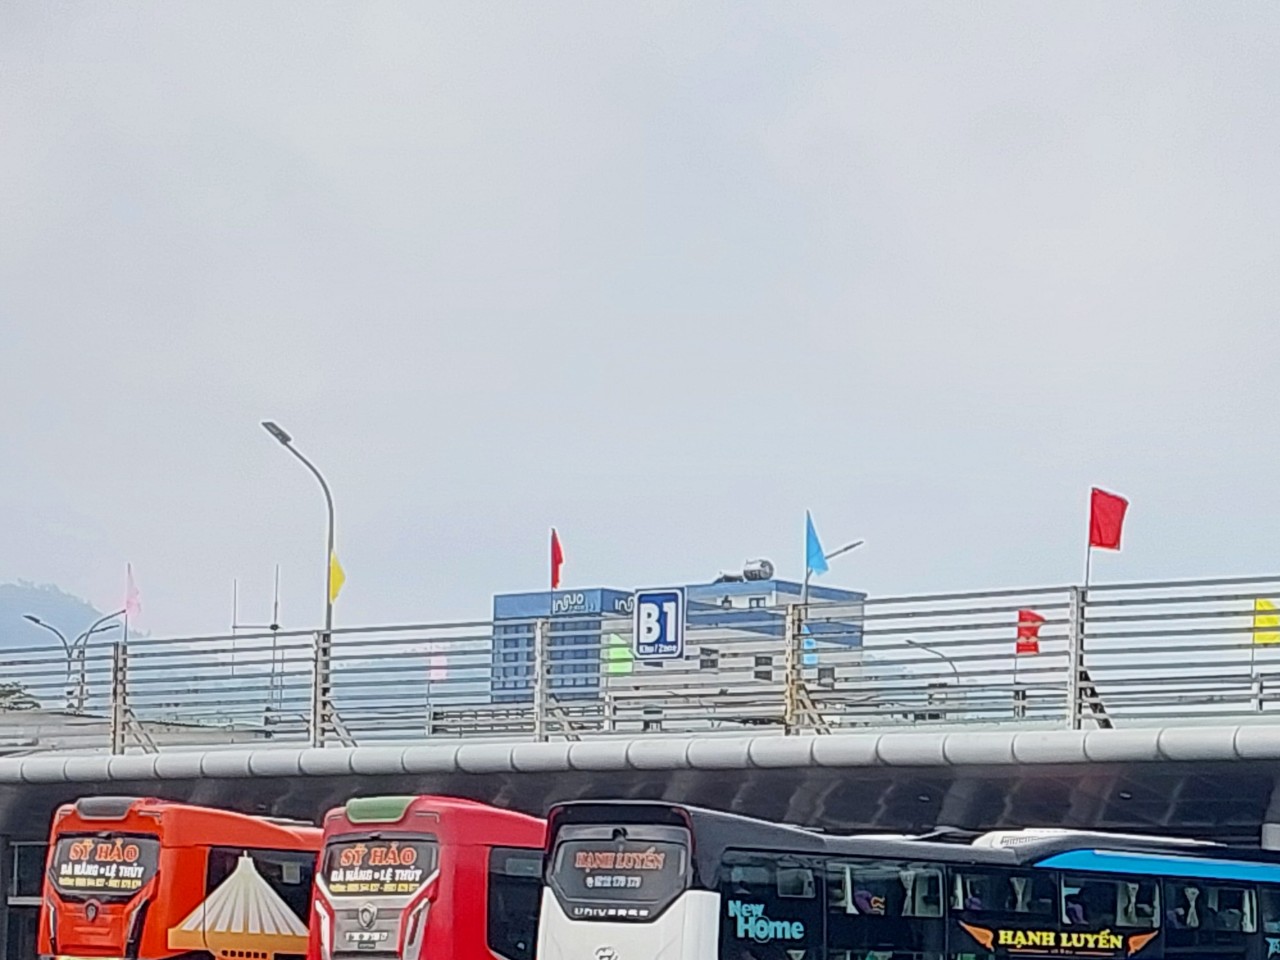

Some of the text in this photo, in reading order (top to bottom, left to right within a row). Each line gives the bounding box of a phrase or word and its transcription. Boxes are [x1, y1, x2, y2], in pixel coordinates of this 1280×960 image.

[640, 602, 676, 643] B1
[728, 900, 765, 917] New
[737, 916, 804, 943] Home
[998, 929, 1123, 949] HẠNH LUYẾN
